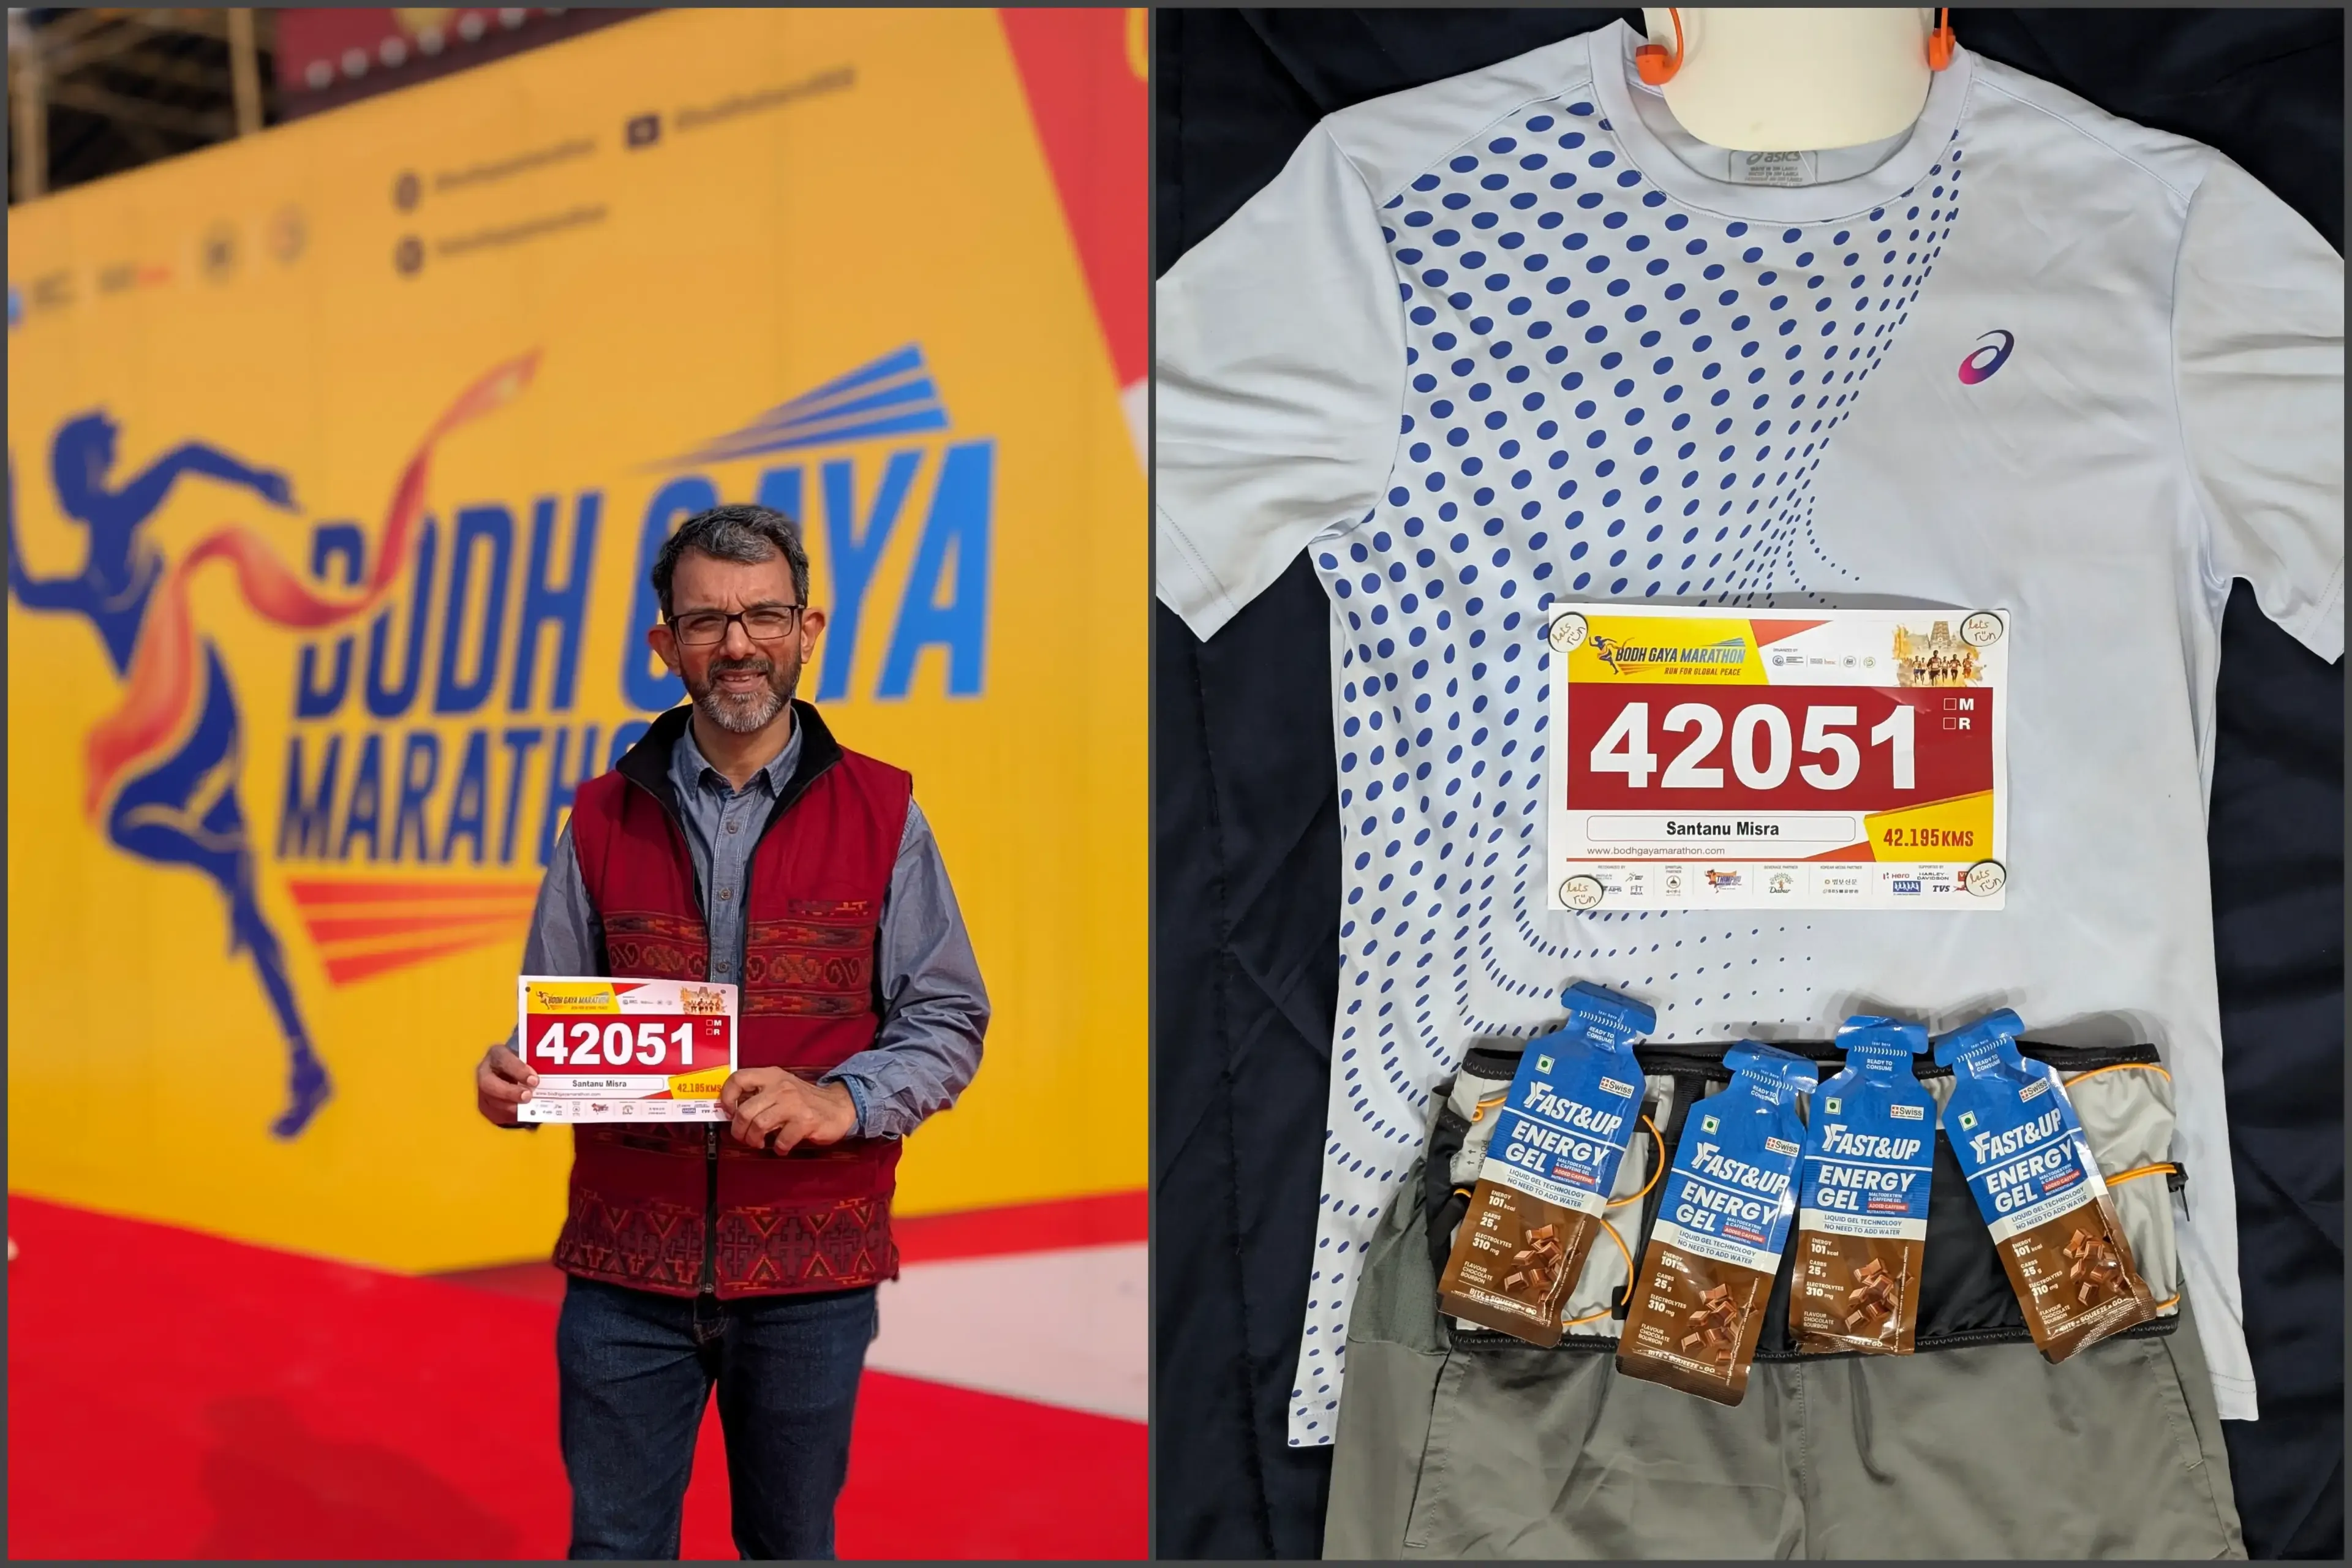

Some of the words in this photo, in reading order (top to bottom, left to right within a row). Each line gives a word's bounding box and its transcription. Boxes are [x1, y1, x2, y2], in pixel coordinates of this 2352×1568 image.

[1765, 151, 1801, 162] asics
[292, 487, 606, 722] BODH
[620, 437, 998, 714] GYA
[1968, 619, 1989, 630] lets
[1616, 647, 1646, 662] BODH
[1649, 648, 1678, 663] GAYA
[1679, 648, 1746, 663] MARATHON
[1959, 698, 1974, 710] M
[1959, 718, 1970, 729] R
[1590, 702, 1916, 791] 42051
[1665, 820, 1732, 836] Santanu
[1736, 821, 1780, 837] Misra
[1883, 828, 1939, 848] 42.195
[1942, 831, 1974, 848] KMS
[1587, 846, 1725, 856] www.bodhgayamarathon.com
[1970, 869, 1989, 884] lets
[1567, 882, 1589, 892] lets
[536, 1022, 693, 1066] 42051
[706, 1084, 722, 1093] KMS
[1608, 1081, 1632, 1095] Swiss
[2027, 1080, 2048, 1095] Swiss
[1523, 1082, 1623, 1135] FAST&UP
[1899, 1106, 1922, 1116] Swiss
[1512, 1120, 1610, 1166] ENERGY
[1822, 1124, 1921, 1160] FAST&UP
[1970, 1108, 2061, 1164] FAST&UP
[1775, 1141, 1798, 1153] Swiss
[1506, 1143, 1547, 1173] GEL
[1691, 1142, 1790, 1194] FAST&UP
[1986, 1139, 2071, 1194] ENERGY
[1509, 1169, 1530, 1180] LIQUID
[1531, 1177, 1542, 1186] GEL
[1541, 1182, 1585, 1199] TECHNOLOGY
[1819, 1165, 1916, 1192] ENERGY
[1491, 1190, 1512, 1200] ENERGY
[1518, 1180, 1534, 1191] NEED
[1544, 1192, 1558, 1201] ADD
[1559, 1197, 1581, 1208] WATER
[1817, 1188, 1860, 1210] GEL
[1995, 1182, 2038, 1213] GEL
[1488, 1196, 1504, 1207] 101
[1504, 1203, 1516, 1212] kcal
[1681, 1181, 1777, 1225] ENERGY
[2011, 1210, 2032, 1223] LIQUID
[2045, 1186, 2084, 1208] TECHNOLOGY
[1483, 1212, 1501, 1220] CARBS
[1676, 1204, 1716, 1232] GEL
[2027, 1215, 2042, 1227] NEED
[2053, 1206, 2065, 1216] ADD
[2067, 1195, 2087, 1208] WATER
[1480, 1217, 1493, 1227] 25
[1472, 1238, 1490, 1250] 310
[1476, 1232, 1512, 1248] ELECTROLYTES
[1679, 1231, 1700, 1242] LIQUID
[1714, 1240, 1756, 1256] TECHNOLOGY
[2012, 1238, 2031, 1250] ENERGY
[1688, 1243, 1704, 1253] NEED
[1730, 1255, 1752, 1265] WATER
[1811, 1243, 1826, 1254] 101
[2015, 1246, 2031, 1257] 101
[2031, 1243, 2043, 1252] kcal
[1661, 1256, 1676, 1268] 101
[1663, 1251, 1683, 1261] ENERGY
[1464, 1261, 1488, 1273] FLAVOUR
[1808, 1266, 1821, 1275] 25
[2021, 1259, 2038, 1268] CARBS
[1460, 1272, 1485, 1284] BOURBON
[1463, 1267, 1493, 1281] CHOCOLATE
[1657, 1272, 1675, 1281] CARBS
[2023, 1267, 2037, 1277] 25
[1654, 1278, 1667, 1289] 25
[1807, 1281, 1844, 1291] ELECTROLYTES
[2029, 1270, 2063, 1289] ELECTROLYTES
[1806, 1287, 1823, 1296] 310
[2032, 1285, 2048, 1297] 310
[1648, 1300, 1665, 1312] 310
[1651, 1294, 1687, 1309] ELECTROLYTES
[2040, 1303, 2061, 1316] FLAVOUR
[2041, 1305, 2071, 1321] CHOCOLATE
[2081, 1305, 2108, 1323] SQUEEZE
[2113, 1298, 2122, 1306] GO
[2044, 1313, 2067, 1325] BOURBON
[1640, 1329, 1670, 1342] CHOCOLATE
[1641, 1323, 1664, 1335] FLAVOUR
[1638, 1333, 1663, 1346] BOURBON
